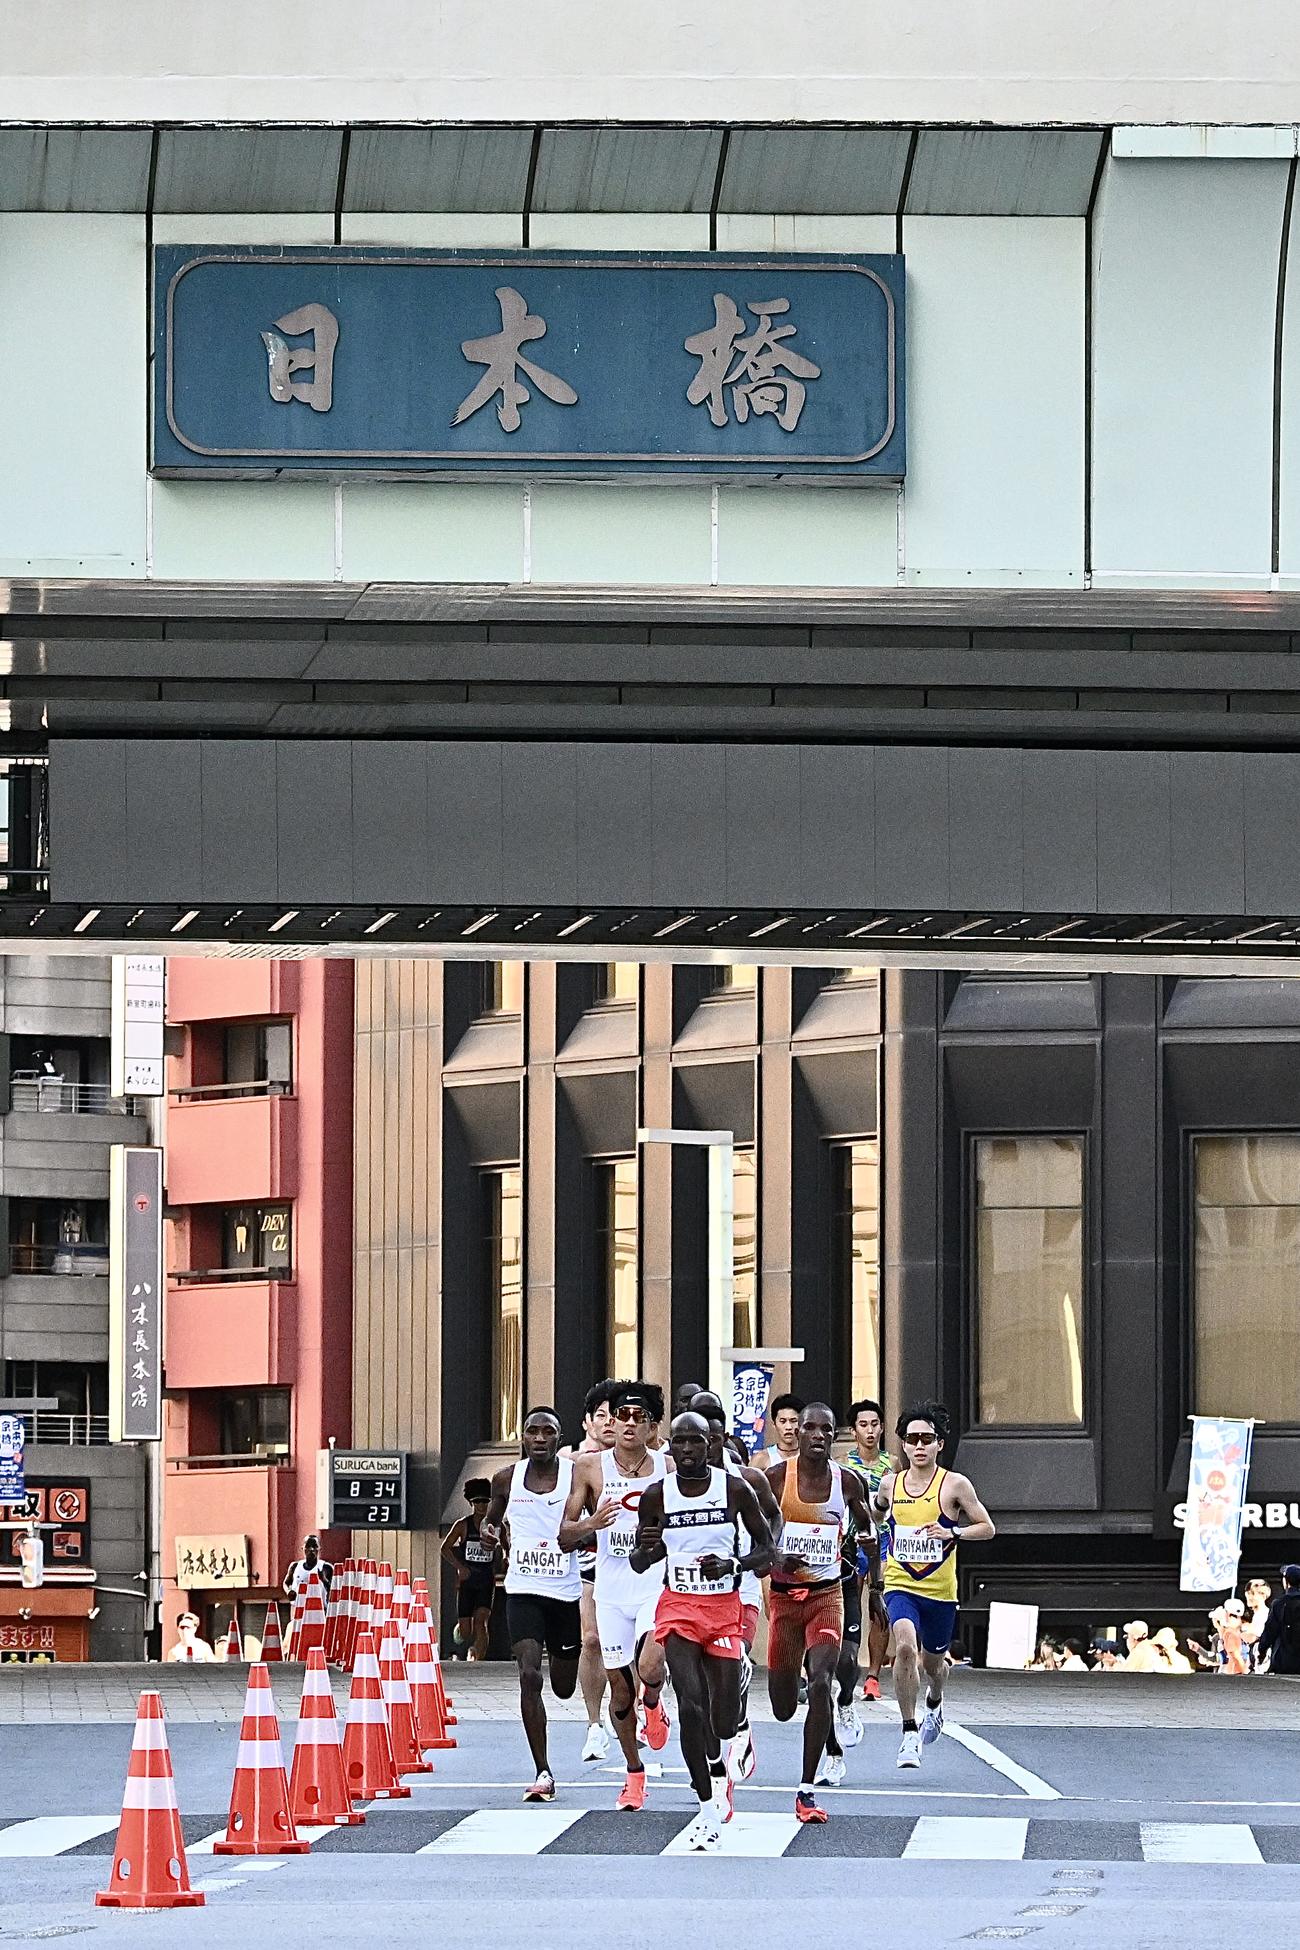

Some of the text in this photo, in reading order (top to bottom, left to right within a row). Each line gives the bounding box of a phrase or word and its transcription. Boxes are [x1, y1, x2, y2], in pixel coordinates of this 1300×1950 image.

[261, 287, 820, 433] 日本橋
[261, 1214, 288, 1231] DEN
[131, 1282, 151, 1408] 八木長本店
[733, 1376, 745, 1416] まつり
[334, 1460, 375, 1471] SURUGA
[377, 1461, 398, 1471] bank
[350, 1482, 395, 1498] 8 34
[368, 1506, 390, 1522] 23
[669, 1510, 724, 1526] 東京國際
[1173, 1503, 1300, 1528] SRB
[786, 1536, 833, 1554] KIPCHIRCHIR
[895, 1538, 936, 1553] KIRIYAMA
[516, 1549, 562, 1567] LANGAT
